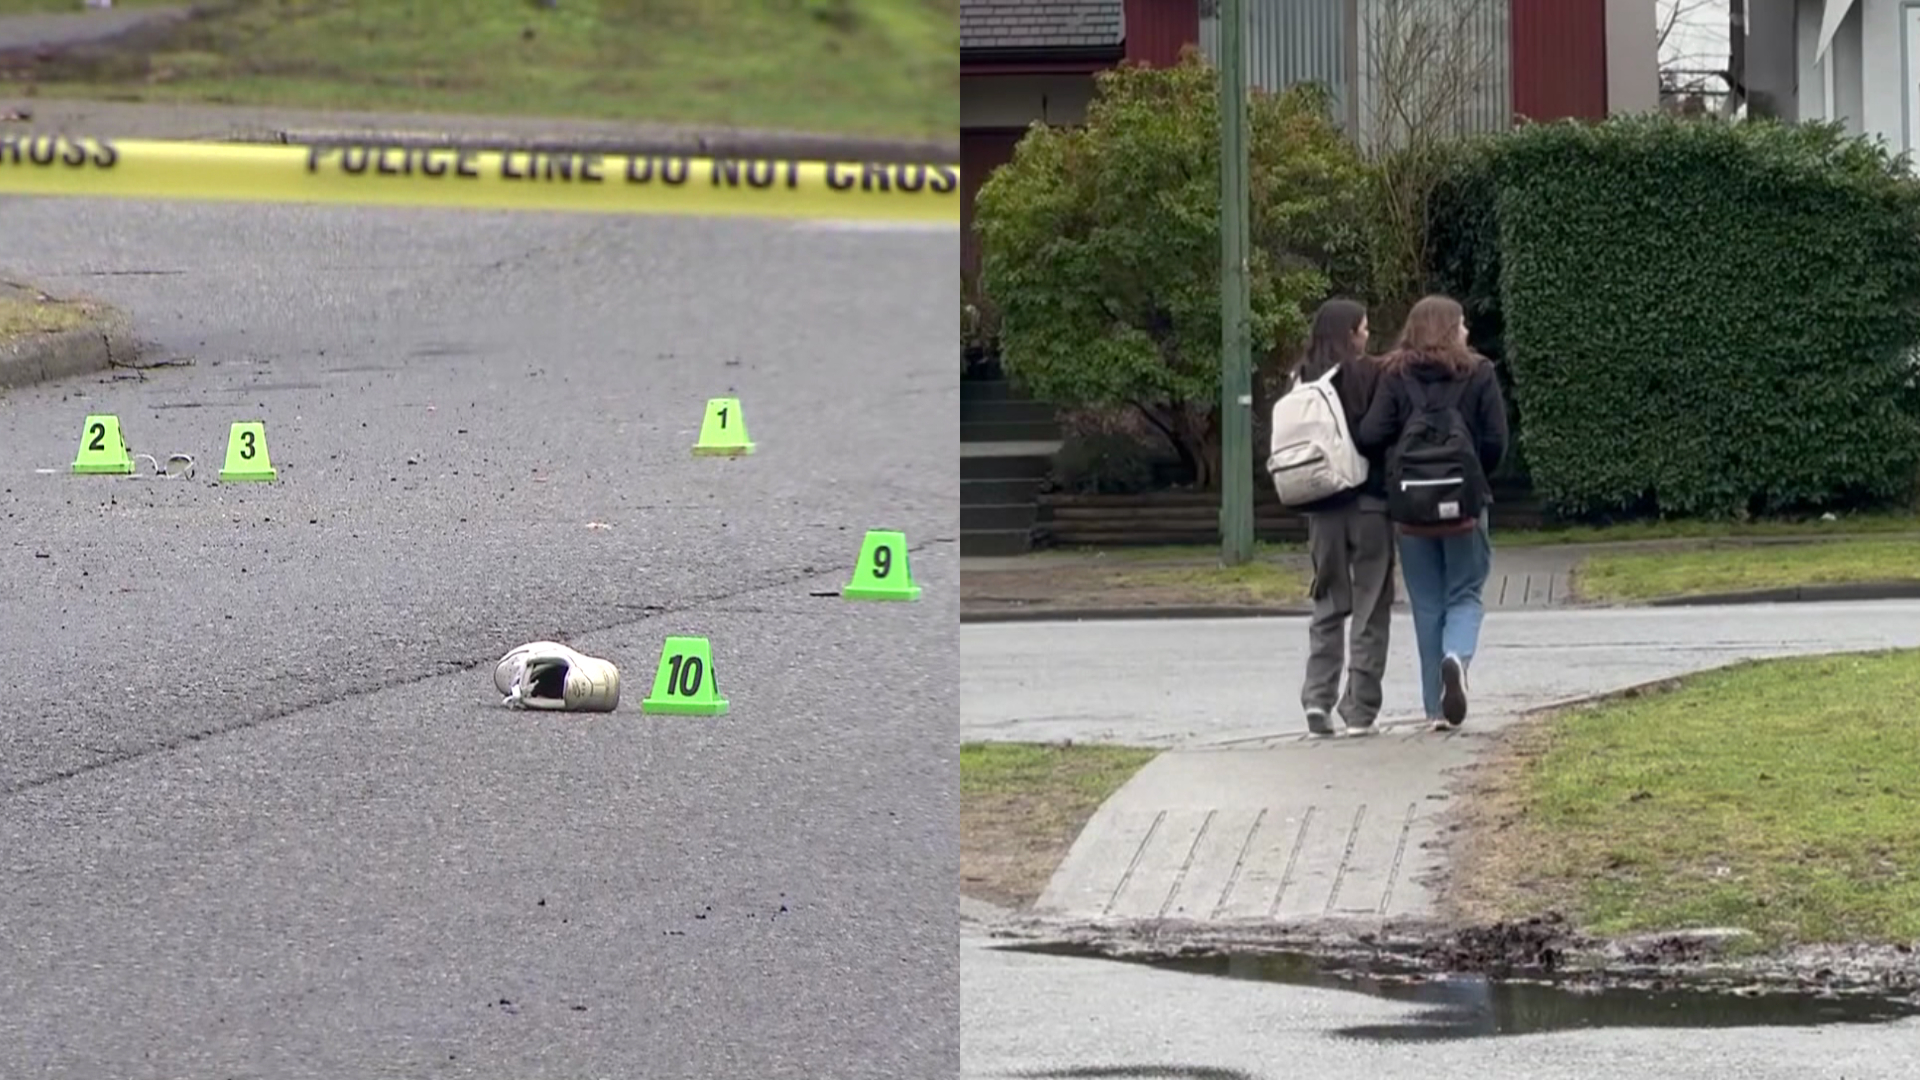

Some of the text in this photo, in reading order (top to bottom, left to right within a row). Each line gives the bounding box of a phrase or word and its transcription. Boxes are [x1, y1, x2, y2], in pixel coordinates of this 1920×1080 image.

[308, 146, 478, 177] POLICE
[501, 152, 603, 182] LINE
[627, 155, 688, 184] DO
[711, 158, 798, 187] NOT
[717, 407, 728, 429] 1
[88, 422, 106, 451] 2
[240, 431, 256, 460] 3
[872, 545, 892, 579] 9
[666, 654, 703, 697] 10
